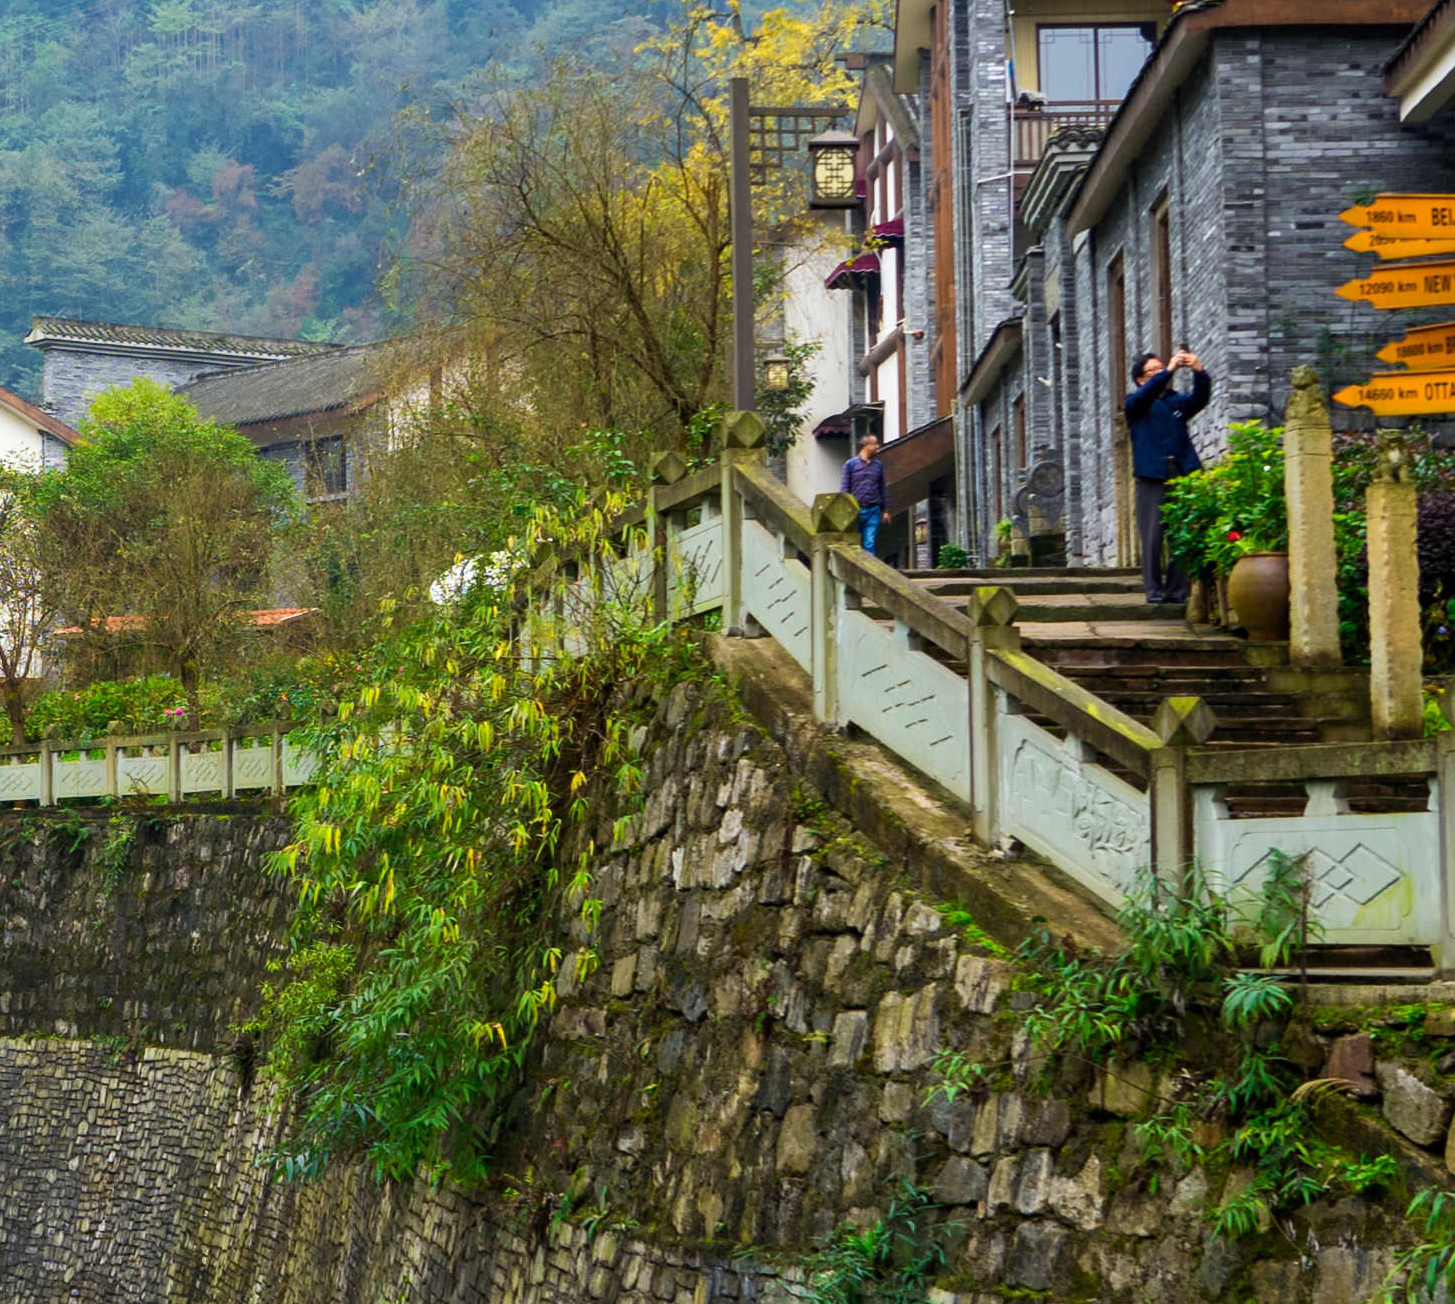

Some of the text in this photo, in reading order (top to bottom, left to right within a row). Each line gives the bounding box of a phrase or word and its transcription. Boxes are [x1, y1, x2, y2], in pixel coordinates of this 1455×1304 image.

[1366, 211, 1394, 223] 1860
[1398, 210, 1416, 223] km
[1359, 281, 1394, 295] 12090
[1397, 280, 1417, 292] km
[1424, 274, 1451, 293] NEW
[1427, 342, 1444, 354] km
[1398, 387, 1418, 399] km
